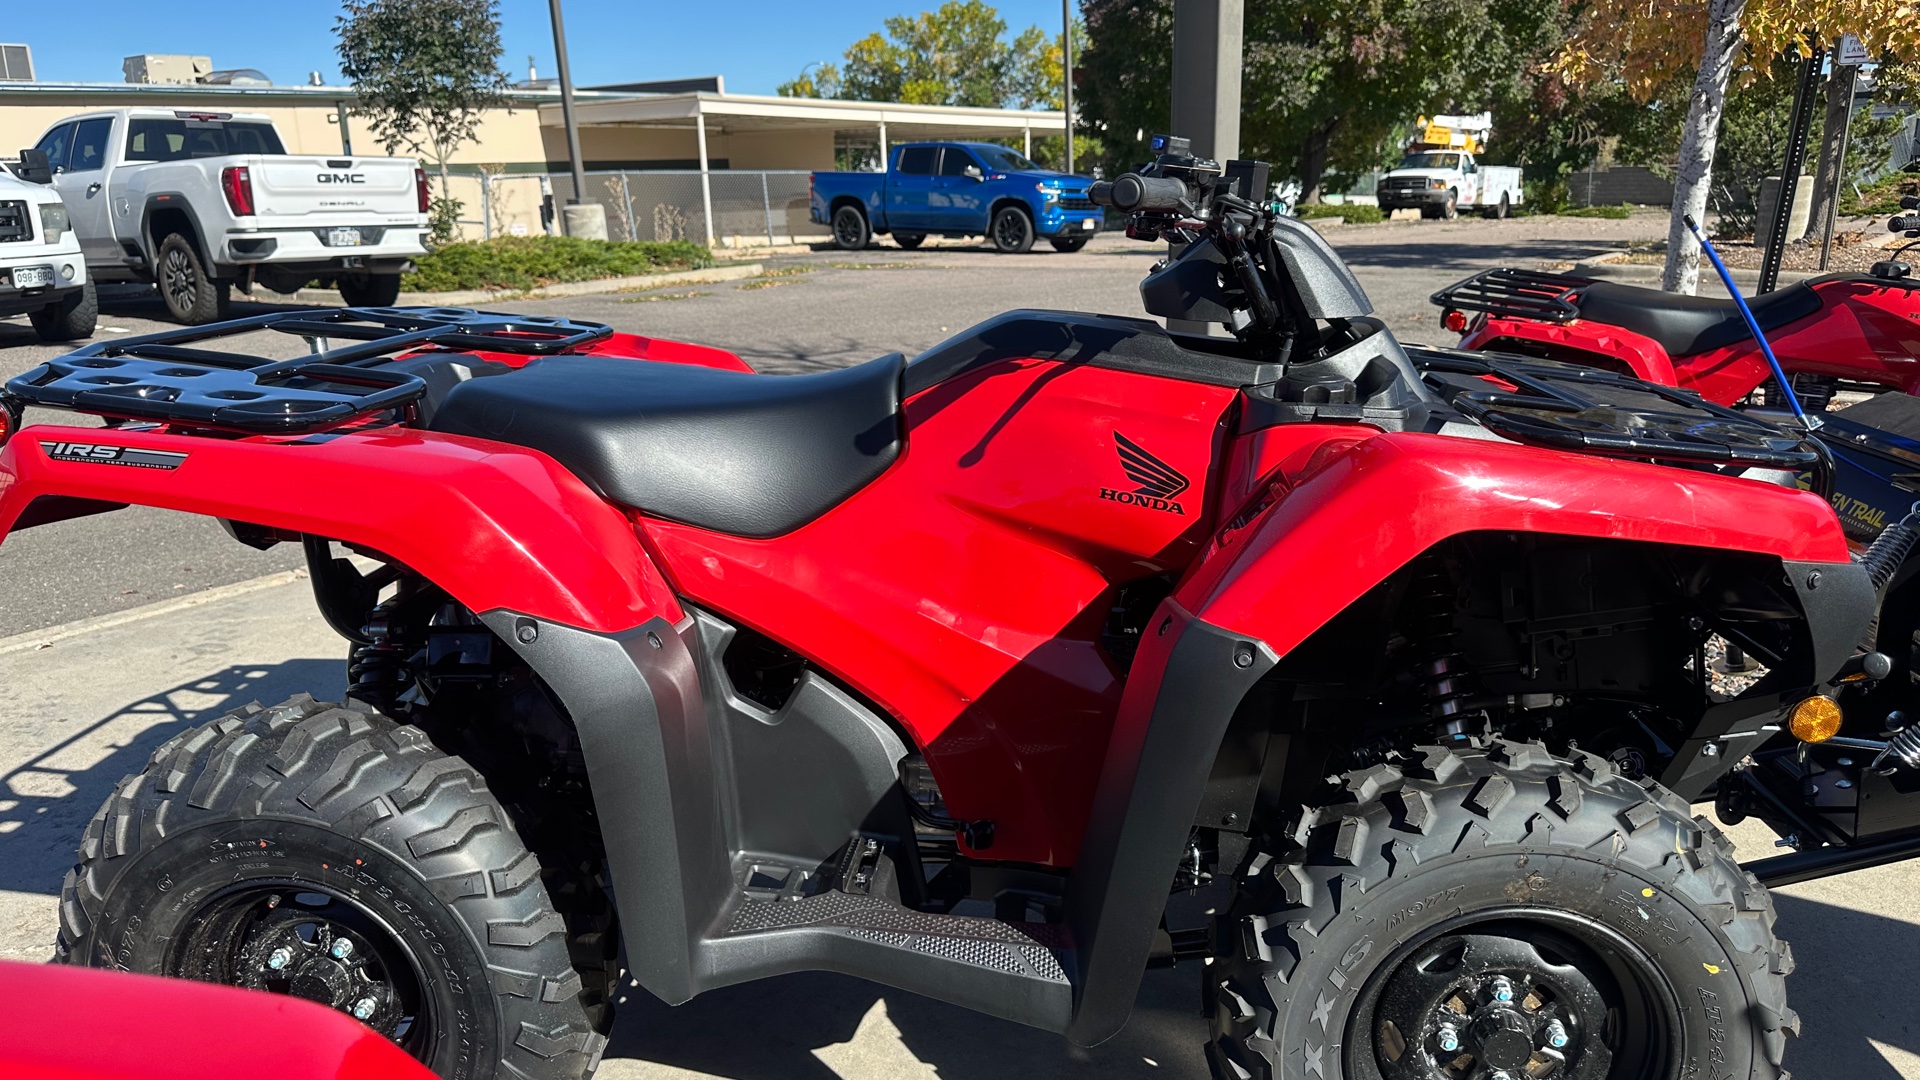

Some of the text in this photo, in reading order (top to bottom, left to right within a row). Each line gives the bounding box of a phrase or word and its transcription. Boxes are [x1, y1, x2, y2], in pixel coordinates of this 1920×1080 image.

[317, 173, 365, 183] GMC
[54, 443, 120, 458] IRS
[1099, 488, 1185, 515] HONDA
[1848, 499, 1886, 528] TRAIL
[1838, 515, 1873, 532] ACCESSORIES
